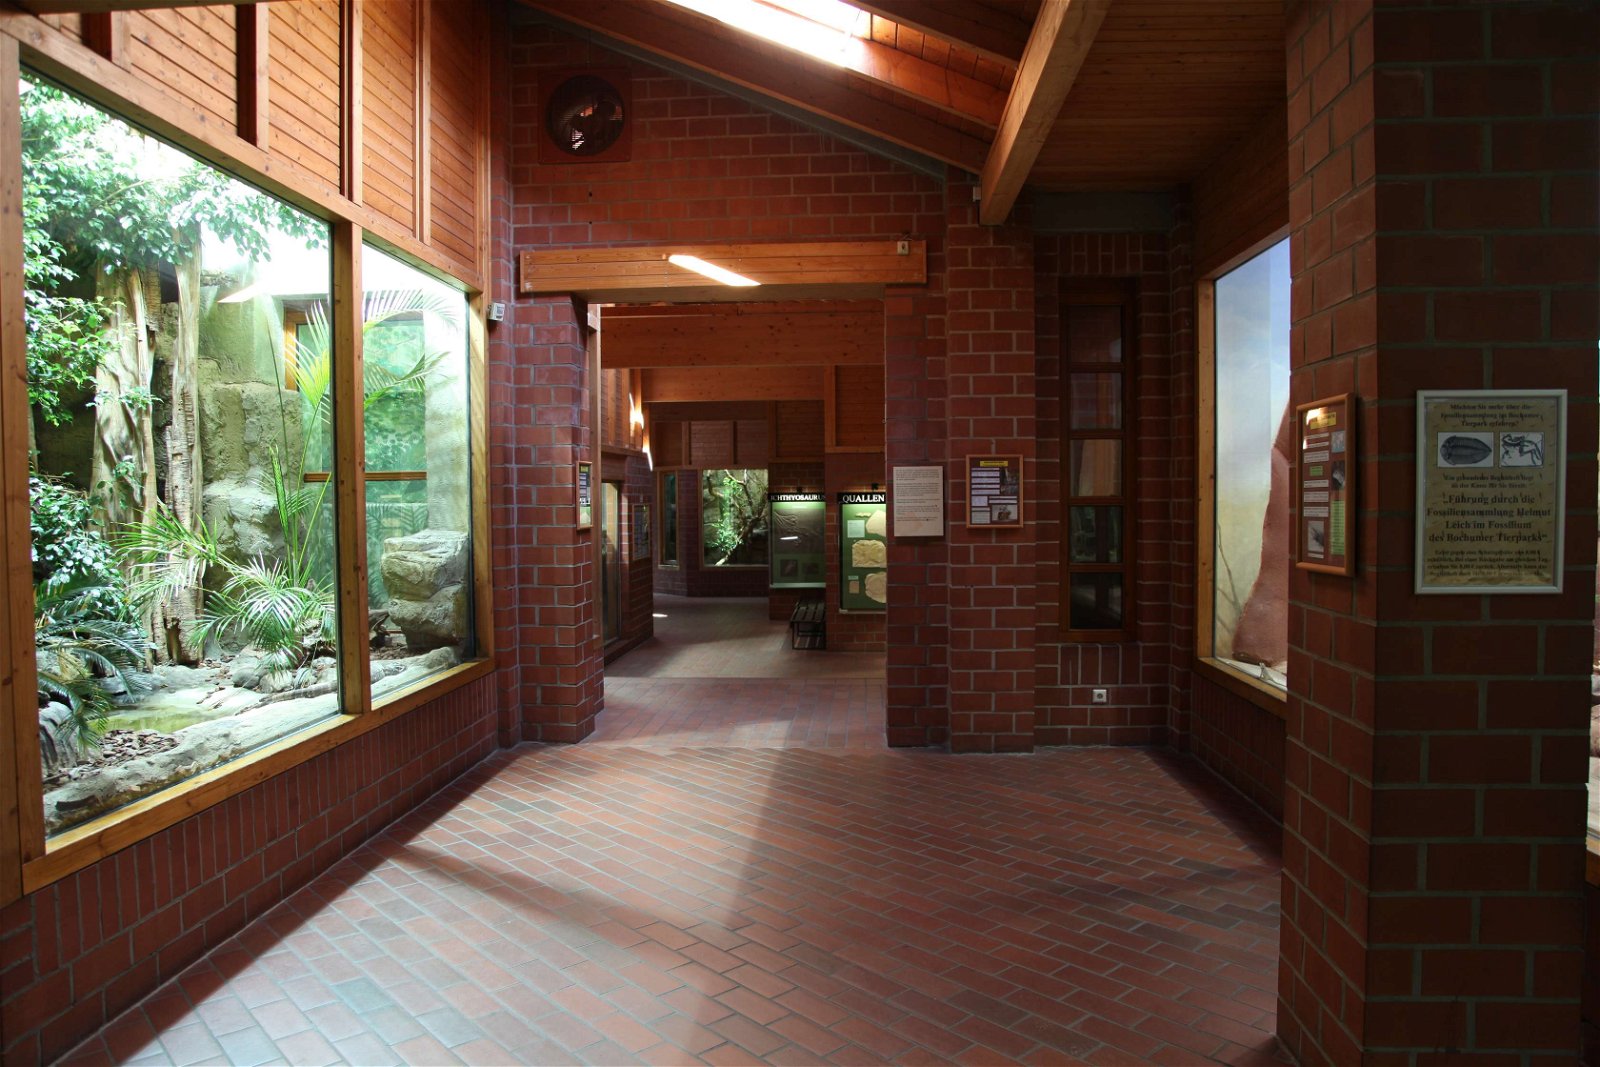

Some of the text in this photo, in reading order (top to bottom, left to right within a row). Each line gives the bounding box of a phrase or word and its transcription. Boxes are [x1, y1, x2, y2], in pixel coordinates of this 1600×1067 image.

[842, 494, 885, 503] QUALLEN
[1491, 495, 1518, 503] durch
[1521, 495, 1535, 503] die
[1427, 508, 1551, 518] Fossiliensammlung Helmut
[1445, 521, 1532, 529] Leich im Fossilium
[1428, 533, 1444, 542] des
[1446, 533, 1494, 542] Bochumer
